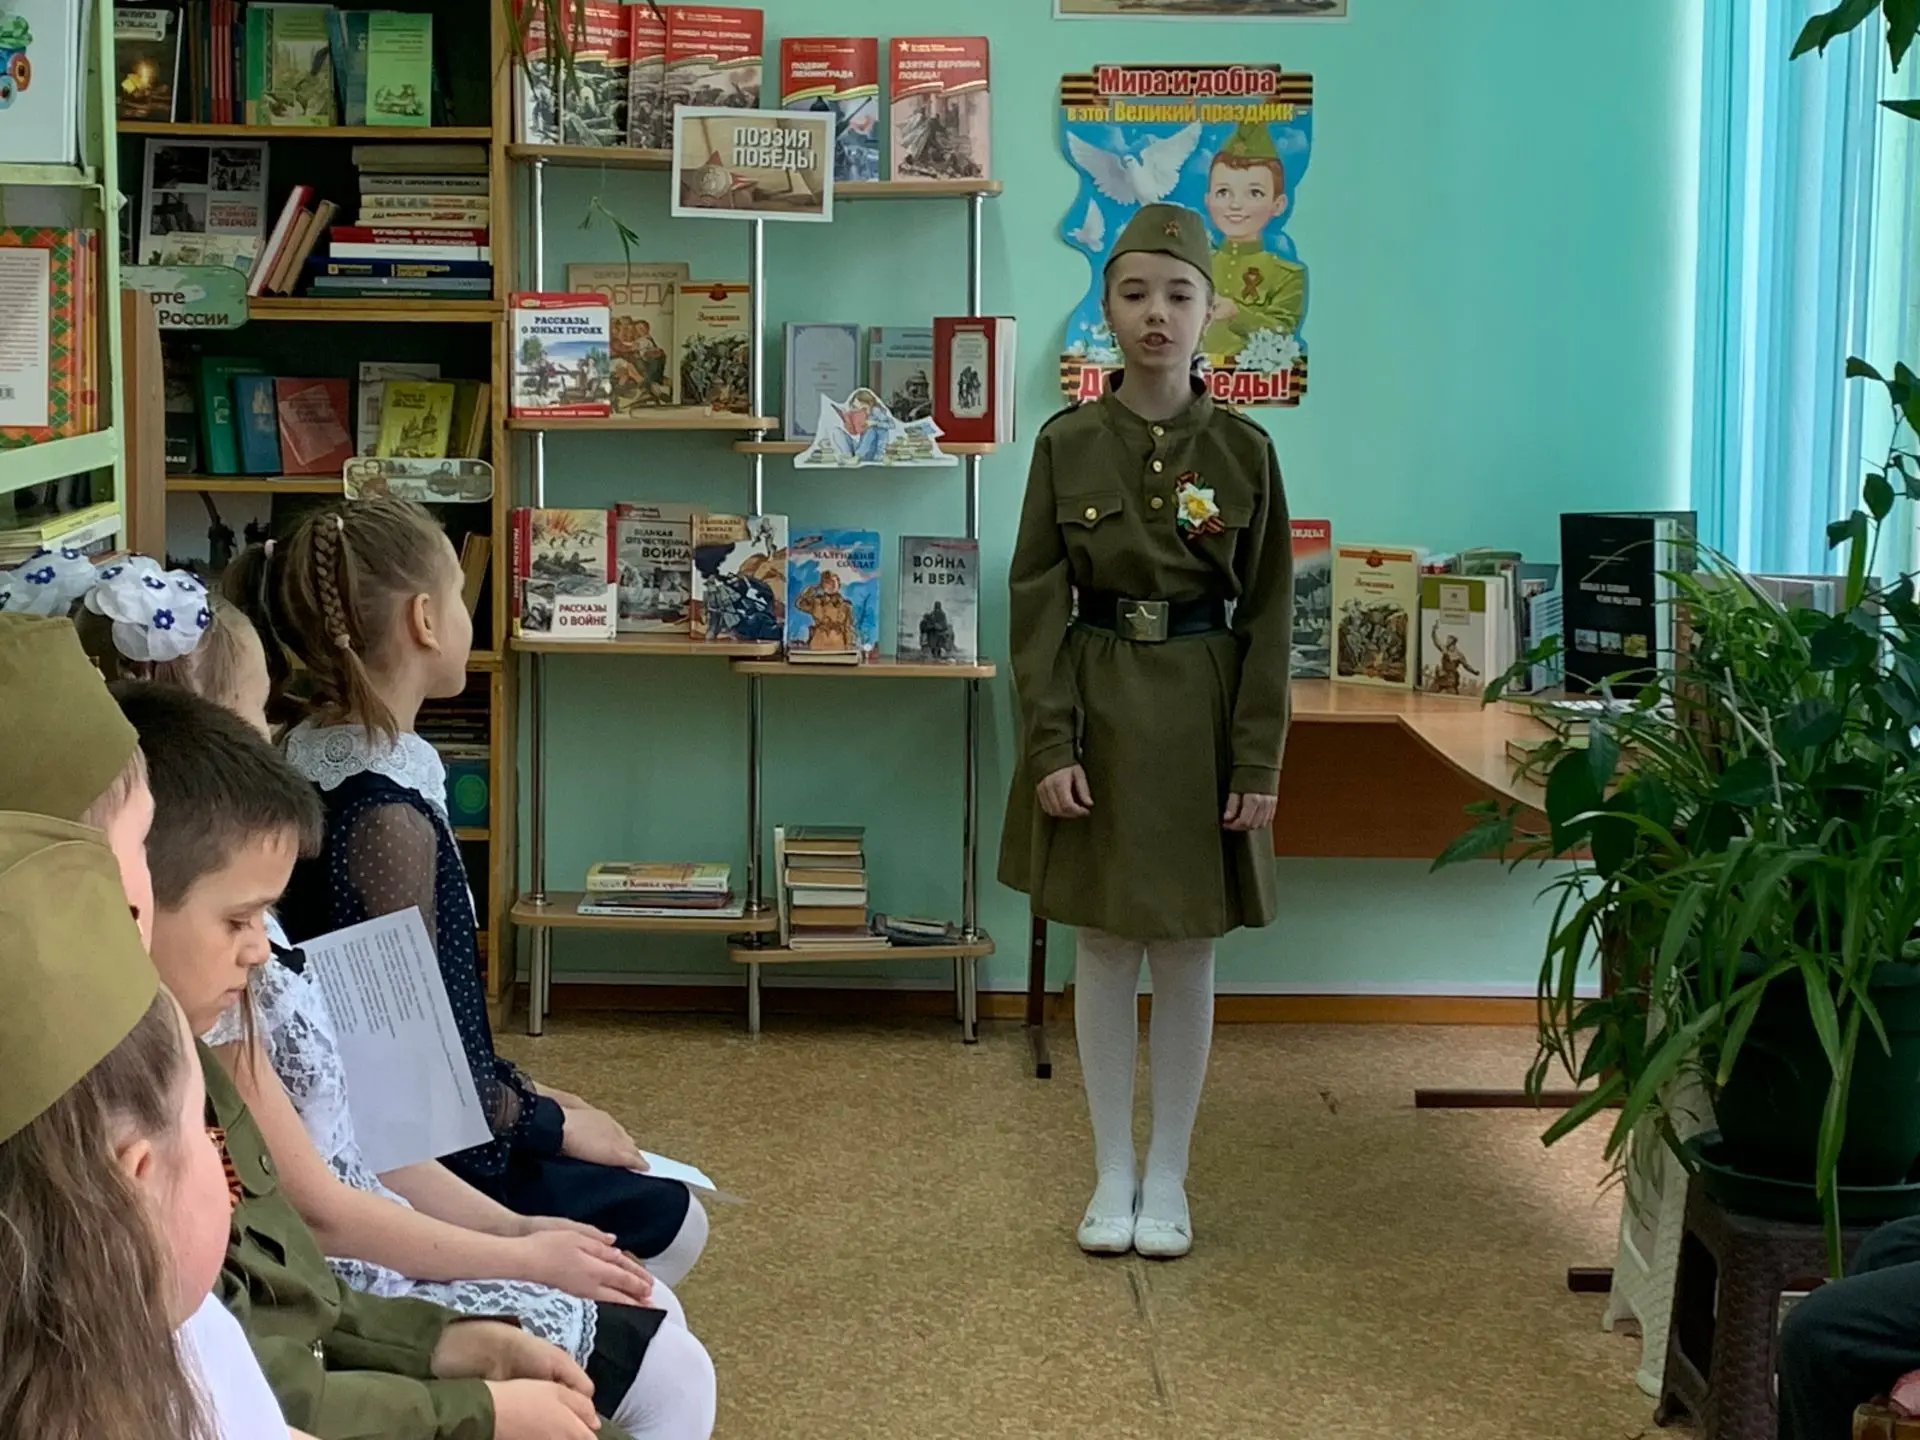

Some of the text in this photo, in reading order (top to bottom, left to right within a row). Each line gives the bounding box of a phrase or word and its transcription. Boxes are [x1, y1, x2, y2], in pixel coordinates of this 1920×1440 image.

[1099, 66, 1276, 96] Мира и добра
[1067, 99, 1294, 124] в этот Великий праздник
[733, 127, 812, 149] ПОЭЗИЯ
[733, 147, 817, 171] ПОБЕДЫ
[150, 291, 186, 304] рте
[159, 310, 229, 325] России
[534, 316, 590, 325] РАССКАЗЫ
[521, 326, 603, 335] О ЮНЫХ ГЕРОЯХ
[1208, 367, 1289, 402] еды!
[625, 536, 691, 546] ОТЕЧЕСТВЕННА
[641, 546, 691, 559] ВОЙНА
[912, 554, 966, 569] ВОЙНА
[913, 573, 965, 585] И ВЕРА
[558, 603, 608, 612] РАССКАЗЫ
[559, 614, 608, 626] О ВОЙНЕ
